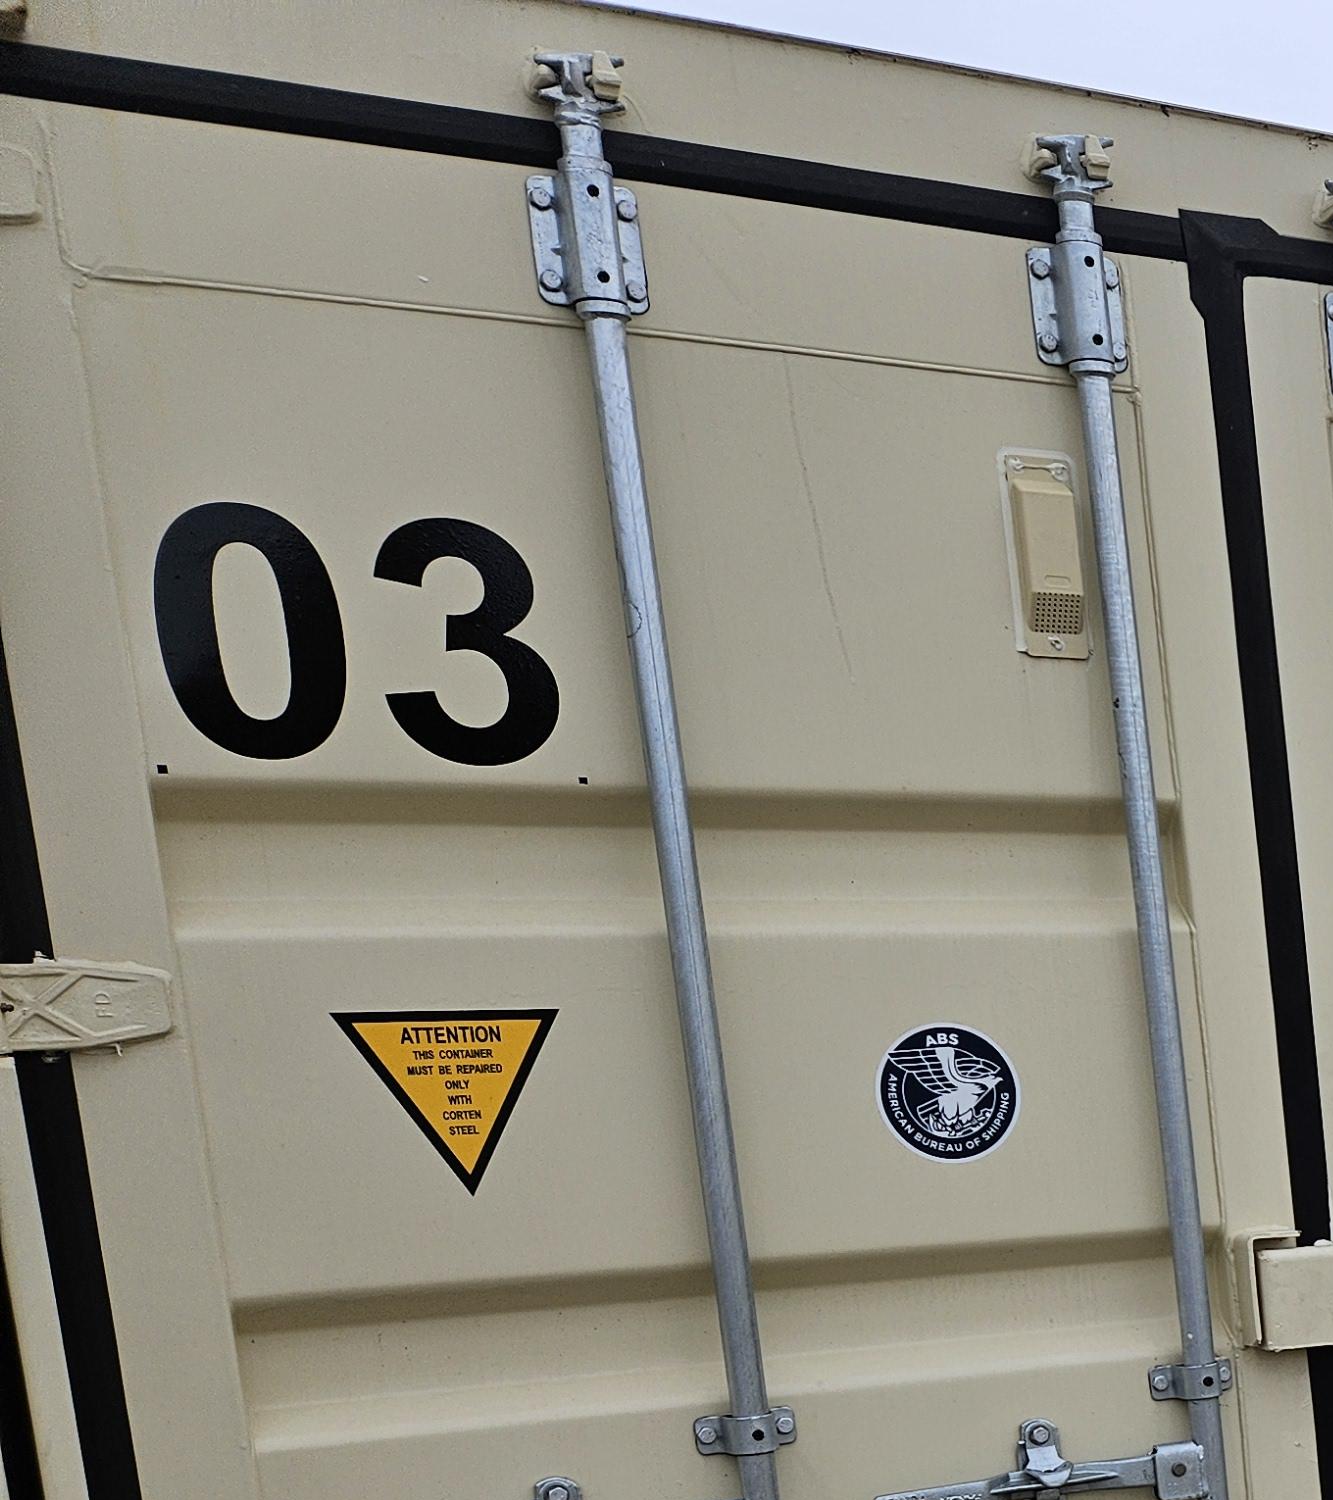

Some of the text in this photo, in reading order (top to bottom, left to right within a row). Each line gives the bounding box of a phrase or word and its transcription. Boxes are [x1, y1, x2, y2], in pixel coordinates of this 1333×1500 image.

[154, 502, 559, 766] 03
[401, 1026, 501, 1044] ATTENTION
[926, 1033, 959, 1047] ABS
[413, 1049, 493, 1060] THIS CONTAINER
[407, 1064, 502, 1075] MUST BE REPAIRED
[445, 1080, 469, 1089] ONLY
[448, 1095, 472, 1105] WITH
[443, 1110, 481, 1120] CORTEN
[887, 1073, 1009, 1152] AMERICAN BUREAU OF SHIPPING
[449, 1126, 479, 1135] STEEL
